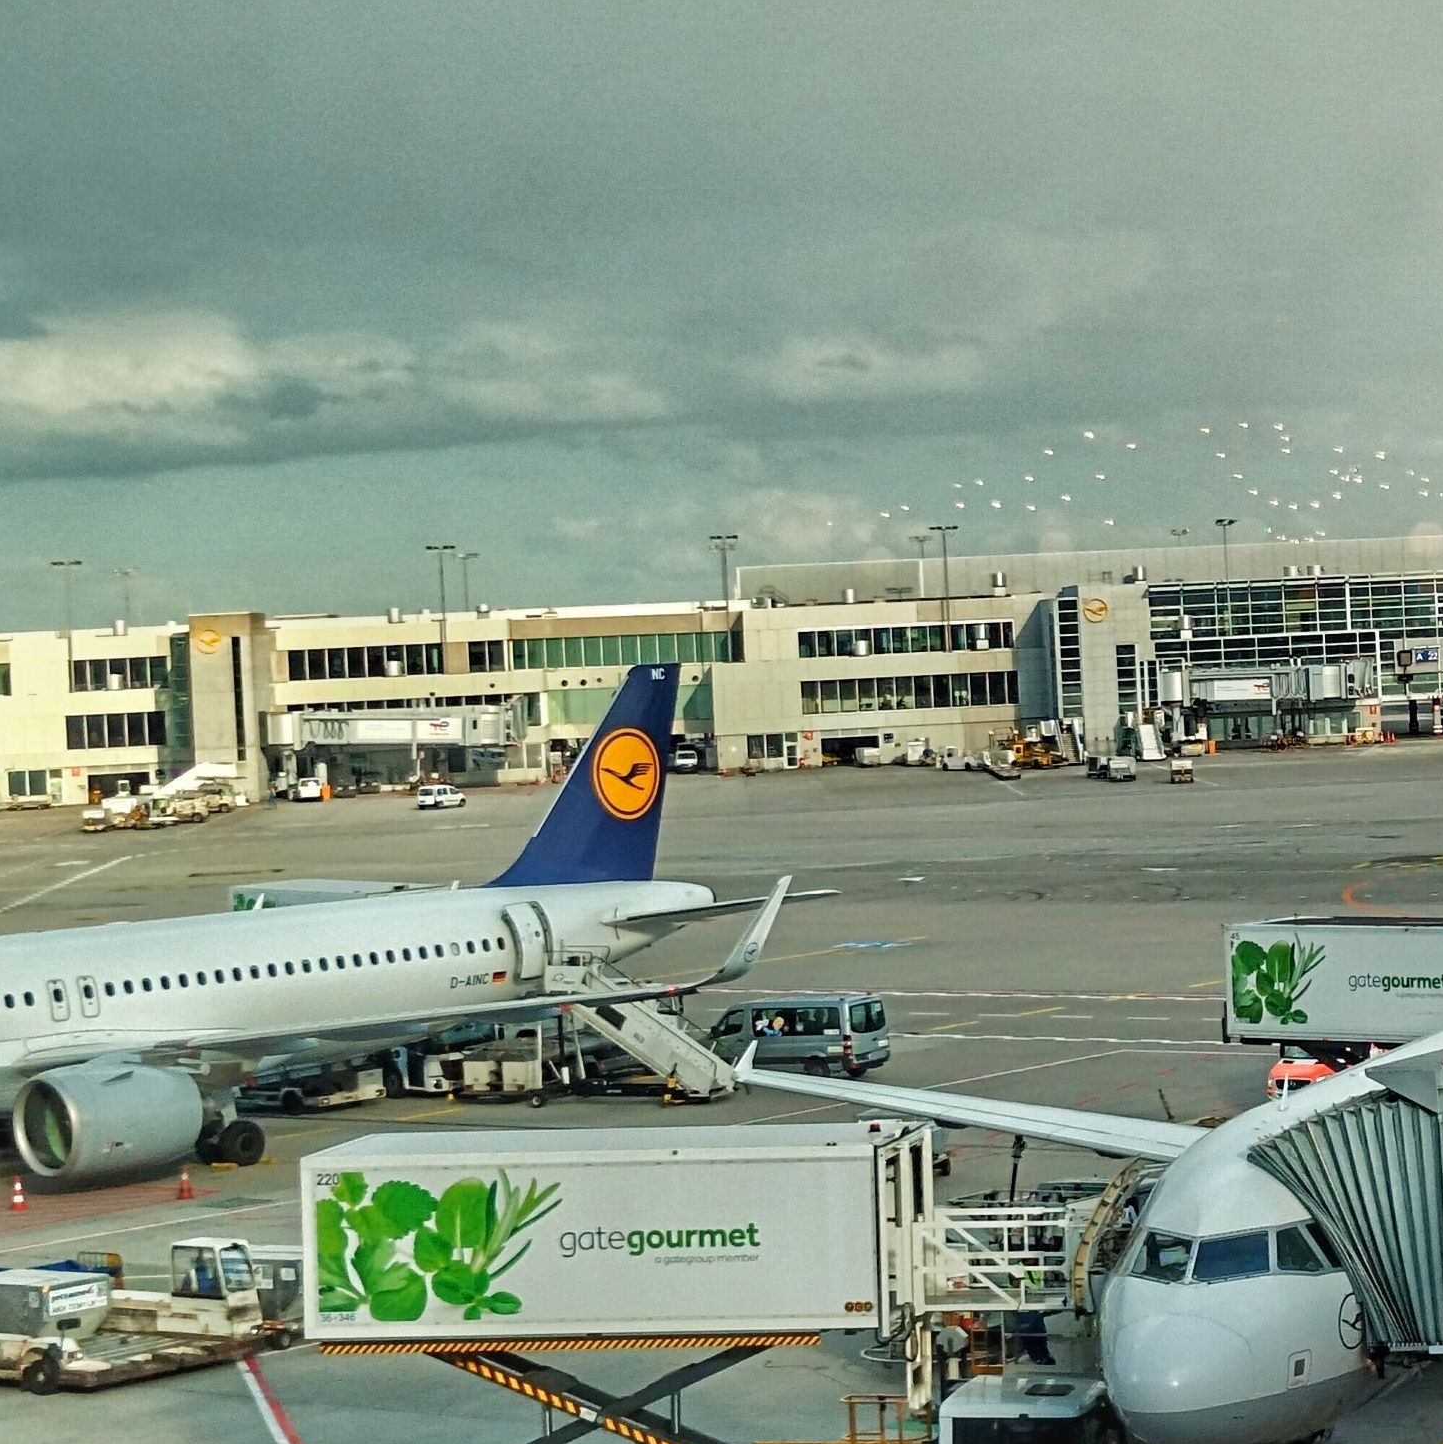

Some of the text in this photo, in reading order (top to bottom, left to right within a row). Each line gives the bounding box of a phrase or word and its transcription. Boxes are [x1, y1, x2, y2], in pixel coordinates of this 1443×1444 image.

[651, 667, 666, 680] NC
[450, 972, 490, 989] D-AINC
[317, 1173, 340, 1186] 220
[560, 1222, 761, 1258] gategourmet
